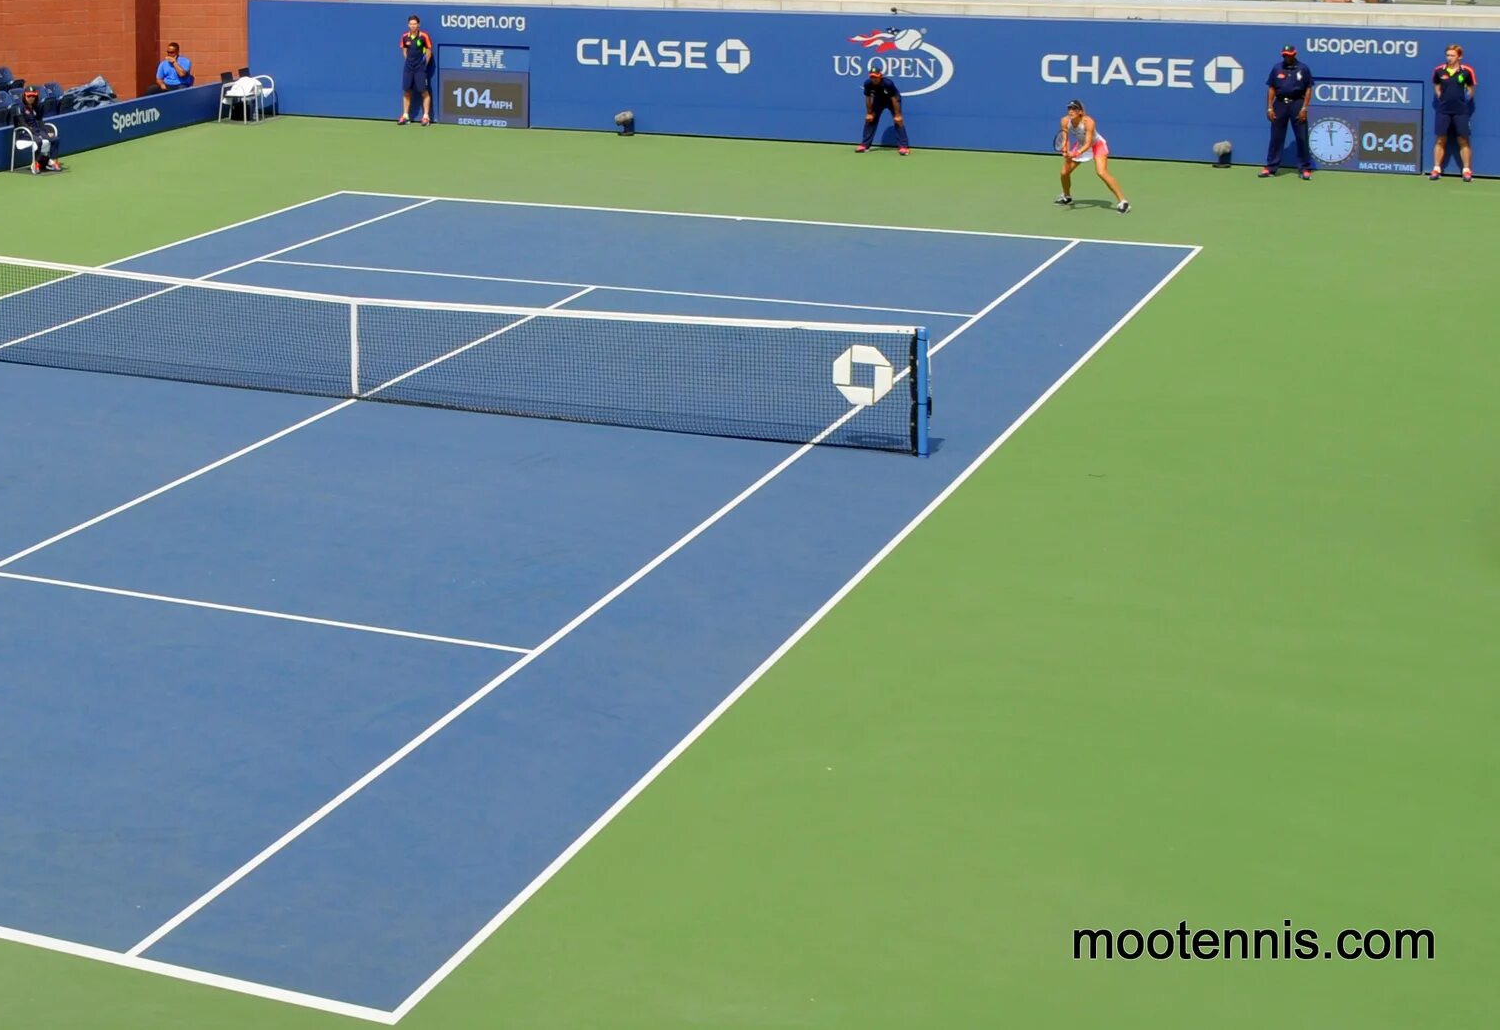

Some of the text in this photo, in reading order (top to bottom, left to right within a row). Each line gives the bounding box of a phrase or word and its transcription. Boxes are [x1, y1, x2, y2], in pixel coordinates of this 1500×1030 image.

[441, 14, 526, 32] usopen.org
[576, 38, 708, 69] CHASE
[1306, 37, 1419, 58] usopen.org
[462, 48, 504, 69] IBM
[832, 55, 936, 78] US OPEN
[1041, 54, 1194, 88] CHASE
[452, 87, 513, 110] 104 MPH
[1314, 83, 1409, 104] CITIZEN
[112, 108, 159, 133] Spectrum
[458, 118, 507, 127] SERVE SPEED
[1362, 132, 1414, 153] 0:46
[1359, 162, 1416, 172] MATCH TIME
